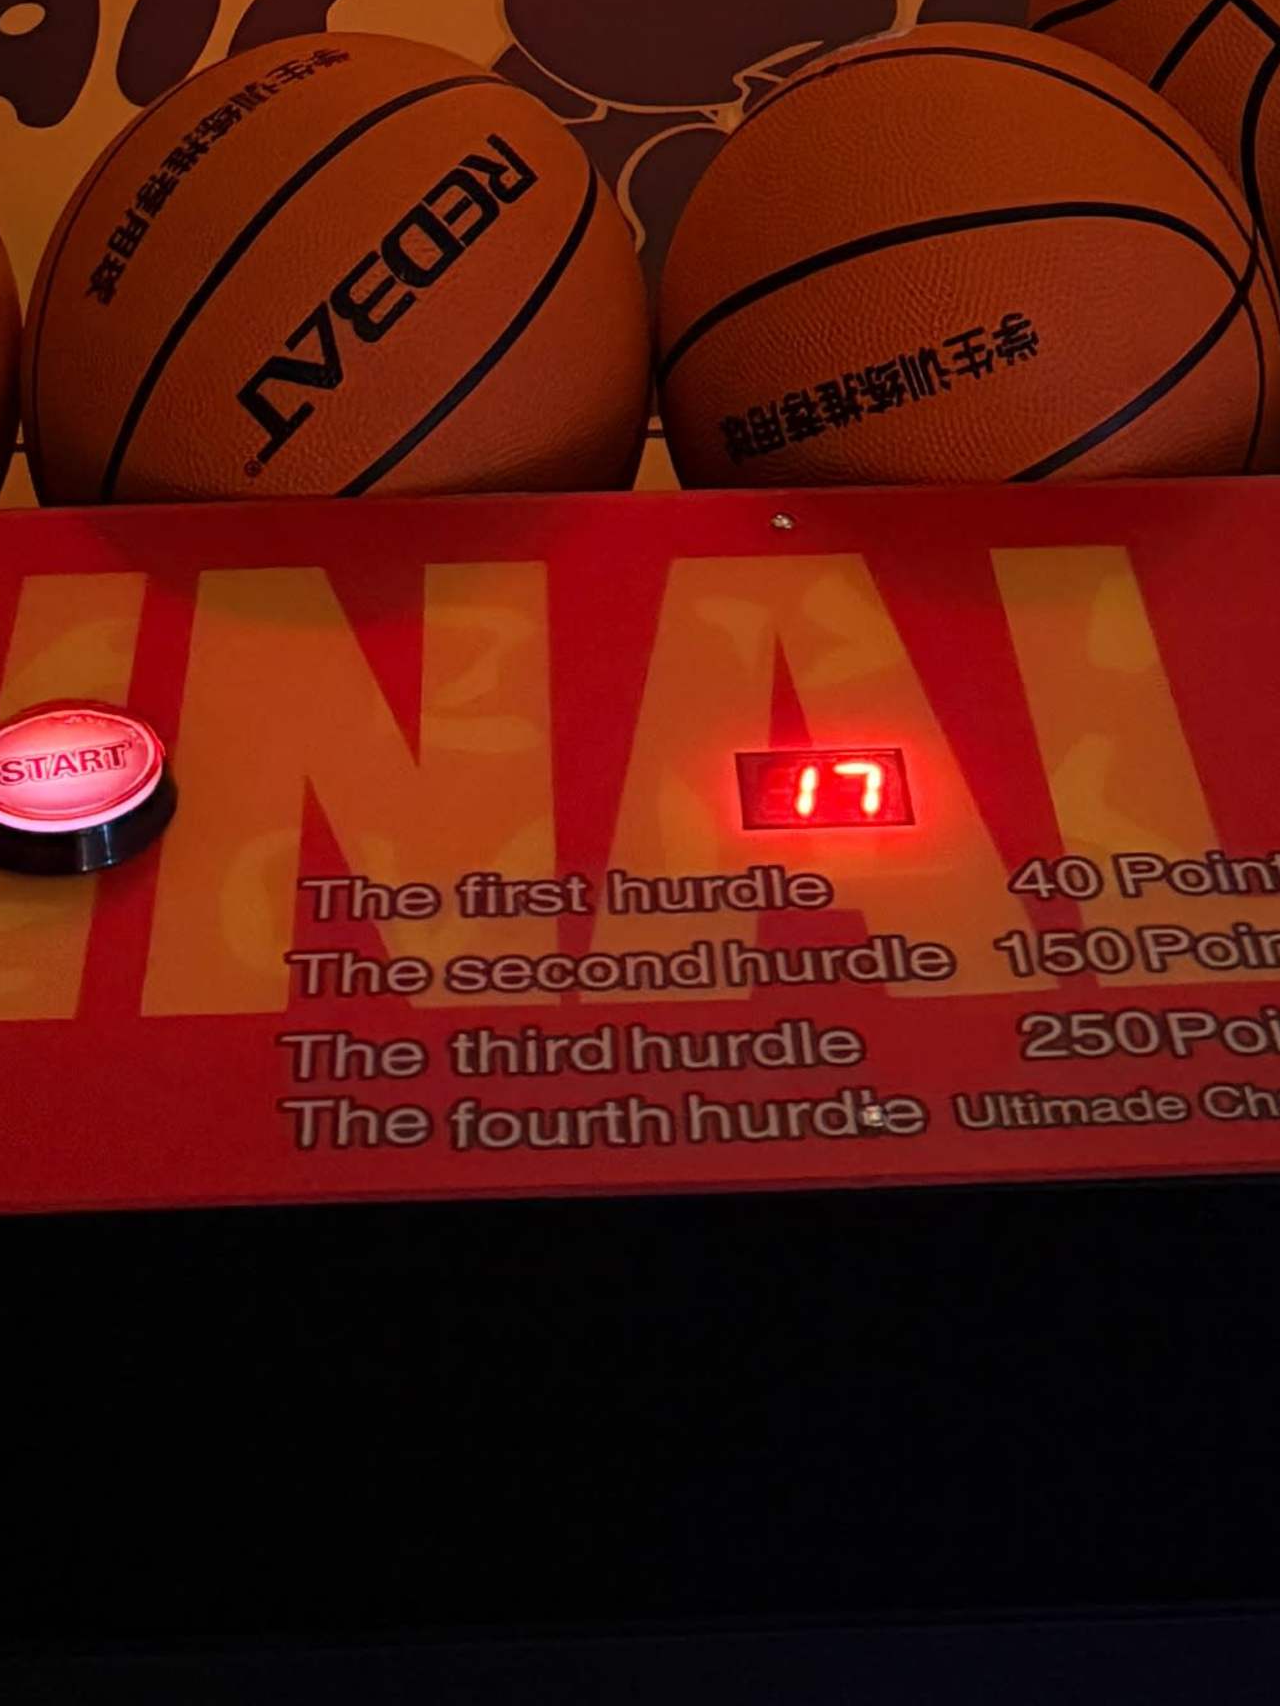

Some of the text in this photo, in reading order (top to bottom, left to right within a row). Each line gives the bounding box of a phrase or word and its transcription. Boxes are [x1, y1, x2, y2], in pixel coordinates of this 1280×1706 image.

[795, 761, 883, 817] 17
[300, 865, 834, 921] The first hurdle
[1008, 856, 1100, 899] 40
[287, 935, 957, 997] The second hurdle
[995, 928, 1136, 977] 150
[280, 1018, 865, 1081] The third hurdle
[282, 1097, 430, 1149] The
[450, 1097, 675, 1150] fourth
[954, 1090, 1190, 1130] Ultimade
